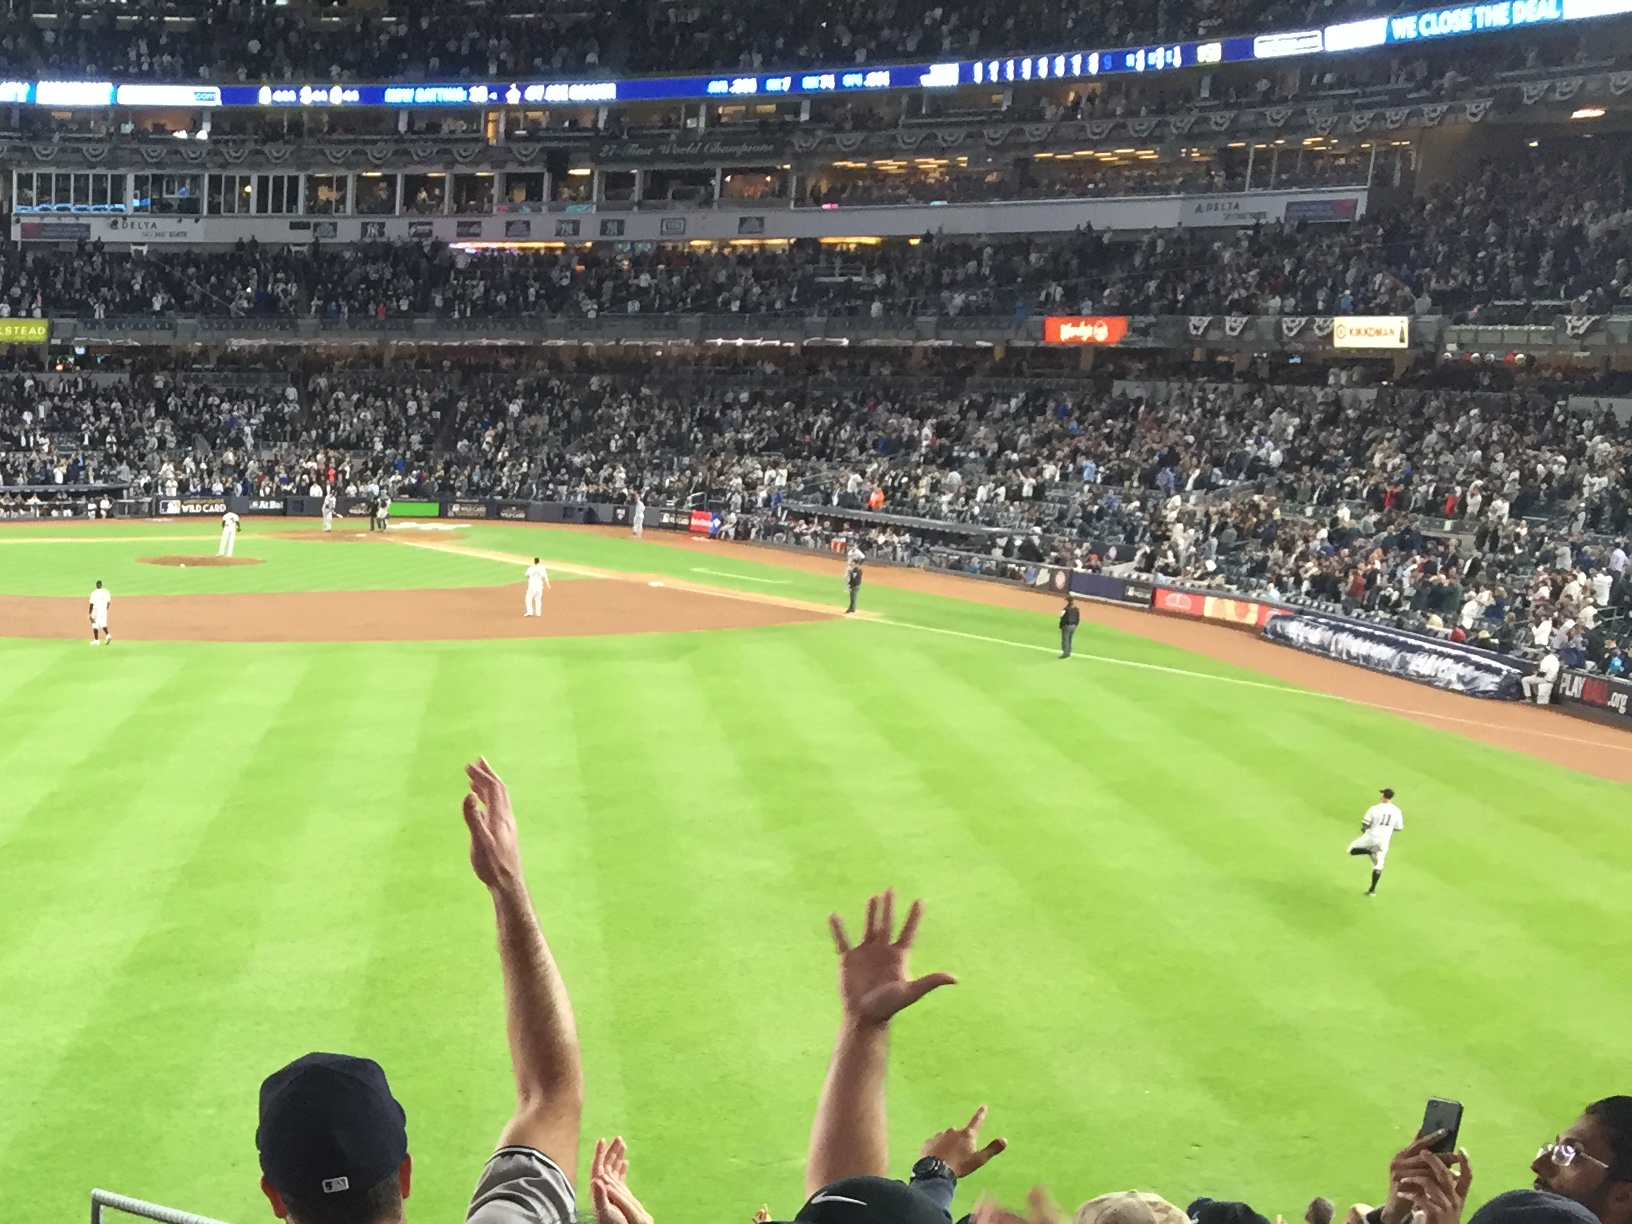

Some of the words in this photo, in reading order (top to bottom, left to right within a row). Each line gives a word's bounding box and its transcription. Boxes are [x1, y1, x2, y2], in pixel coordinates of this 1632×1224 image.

[1392, 16, 1419, 41] WE
[1419, 9, 1473, 37] CLOSE
[1473, 4, 1511, 29] THE
[1512, 0, 1561, 25] DEAL
[122, 221, 158, 229] DELTA
[1349, 327, 1395, 337] KIKKOMAN
[181, 503, 202, 513] WILD
[202, 503, 226, 513] CARD
[1380, 814, 1391, 826] 11
